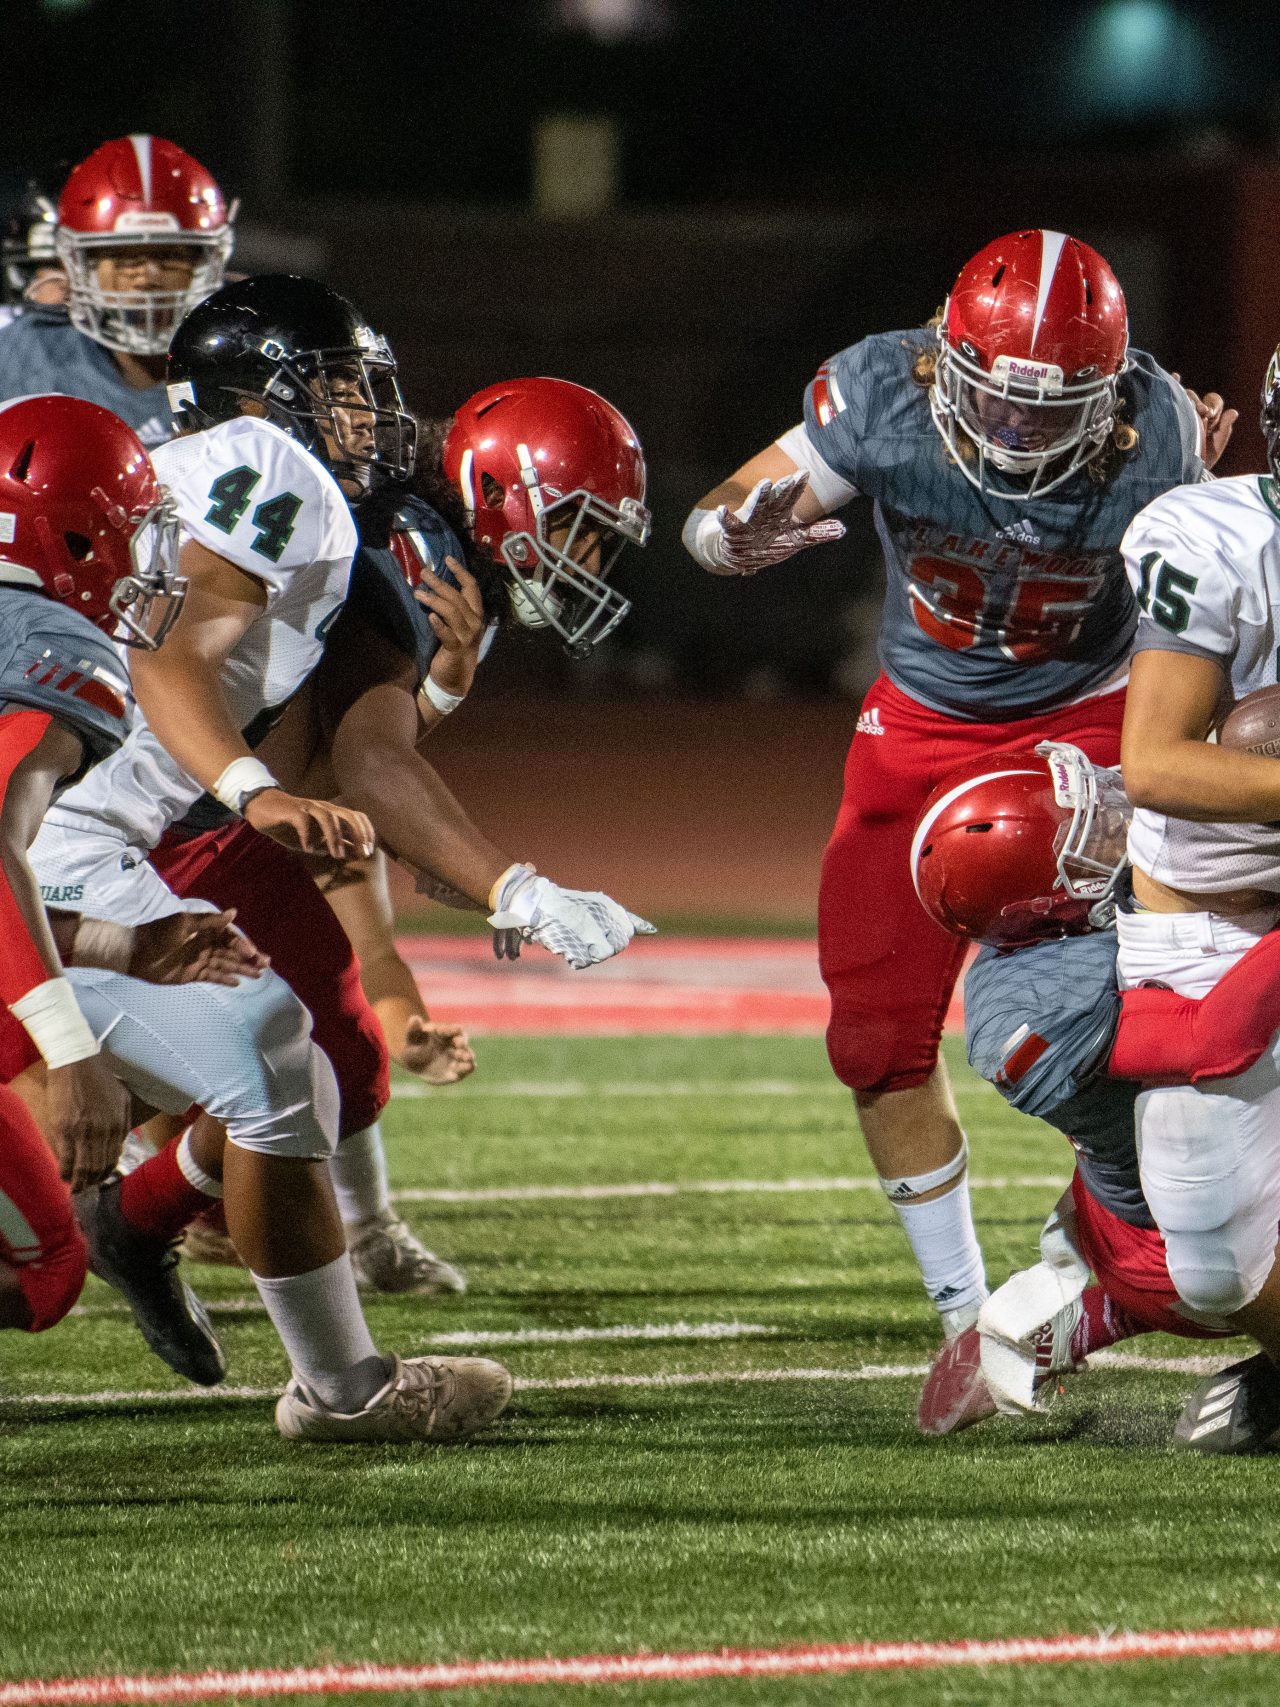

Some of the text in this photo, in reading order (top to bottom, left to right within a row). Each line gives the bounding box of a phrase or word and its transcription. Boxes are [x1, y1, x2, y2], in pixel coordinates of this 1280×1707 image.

[1009, 362, 1048, 379] Riddell
[203, 465, 304, 564] 44
[995, 530, 1041, 545] adidas
[1136, 550, 1199, 634] 15
[40, 885, 84, 901] UARS
